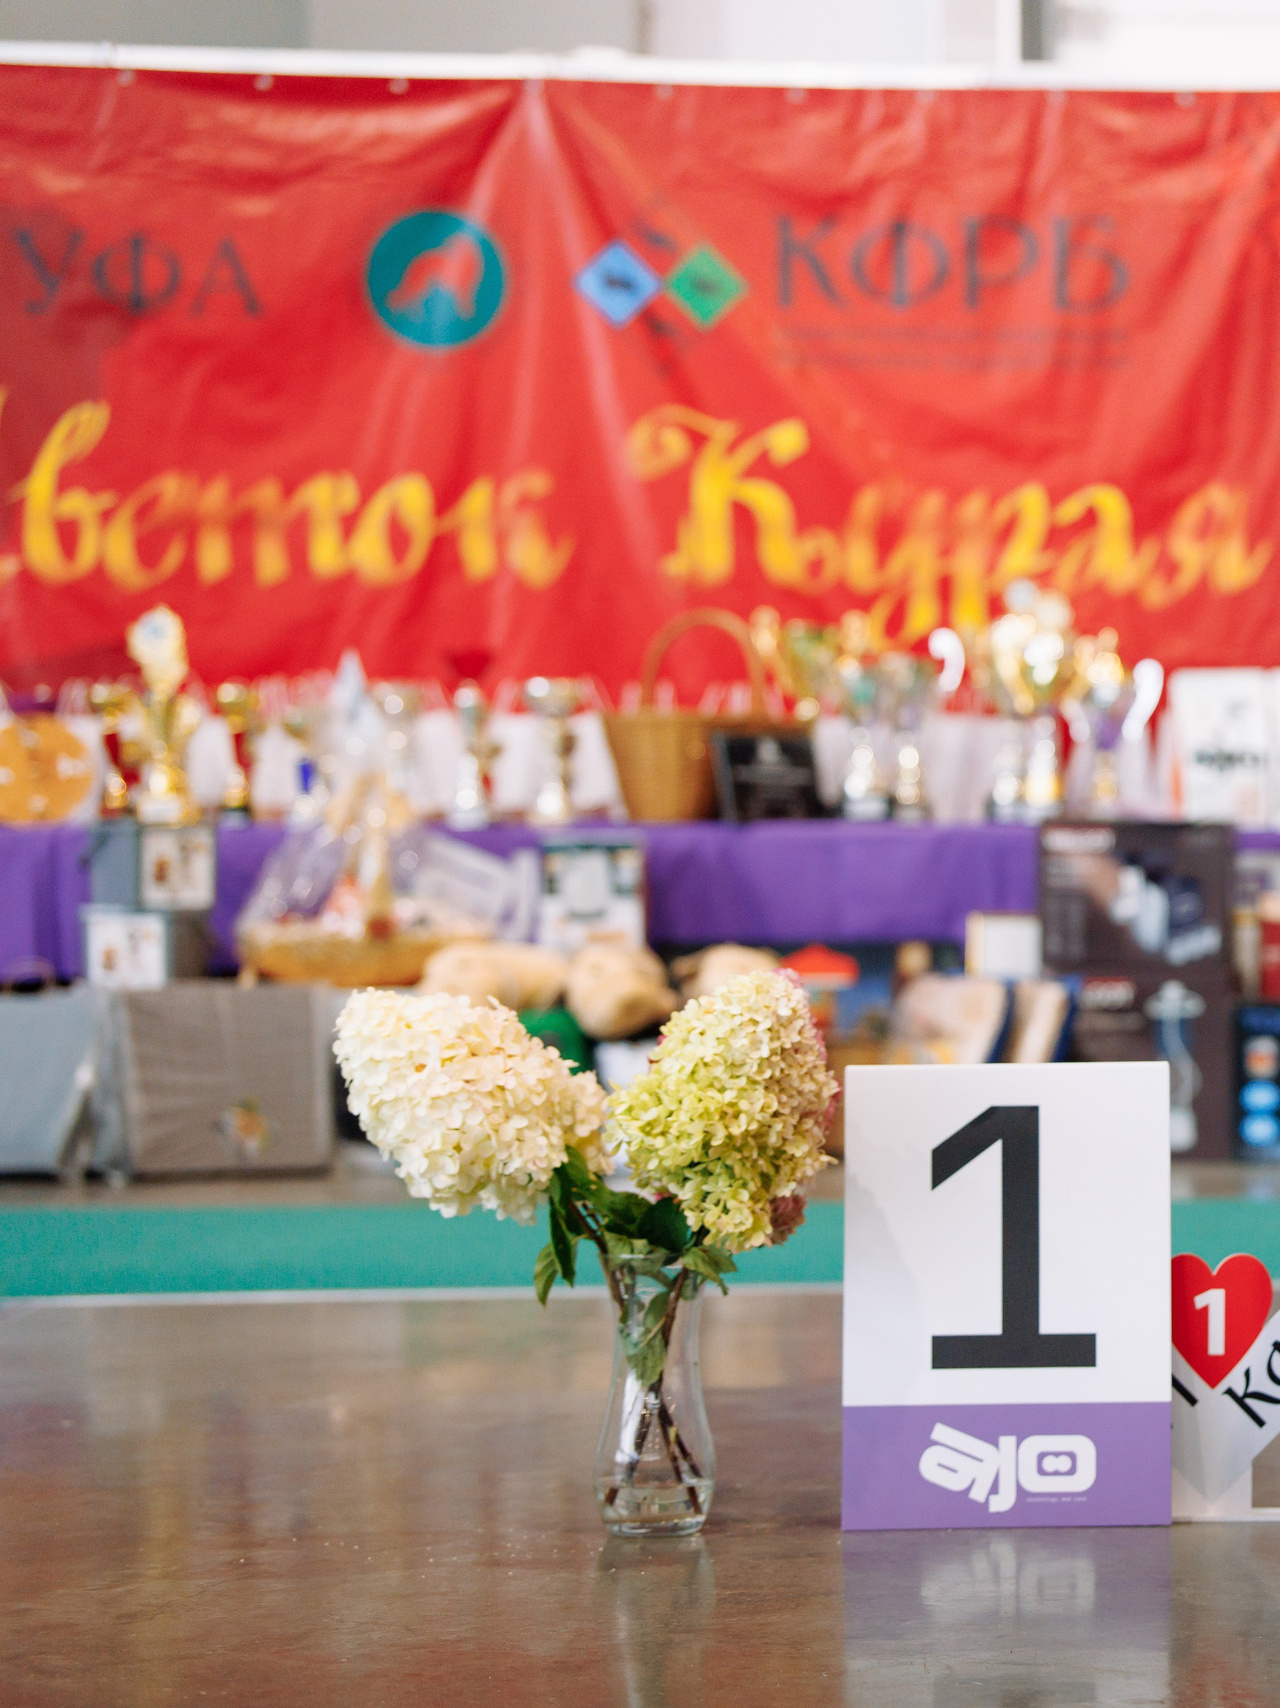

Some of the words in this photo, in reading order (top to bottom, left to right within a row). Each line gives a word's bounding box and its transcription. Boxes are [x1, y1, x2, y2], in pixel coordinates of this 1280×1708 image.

[14, 226, 264, 318] УФА
[774, 213, 1132, 312] КФРБ
[0, 396, 575, 590] веток
[931, 1105, 1097, 1370] 1
[1194, 1288, 1226, 1356] 1
